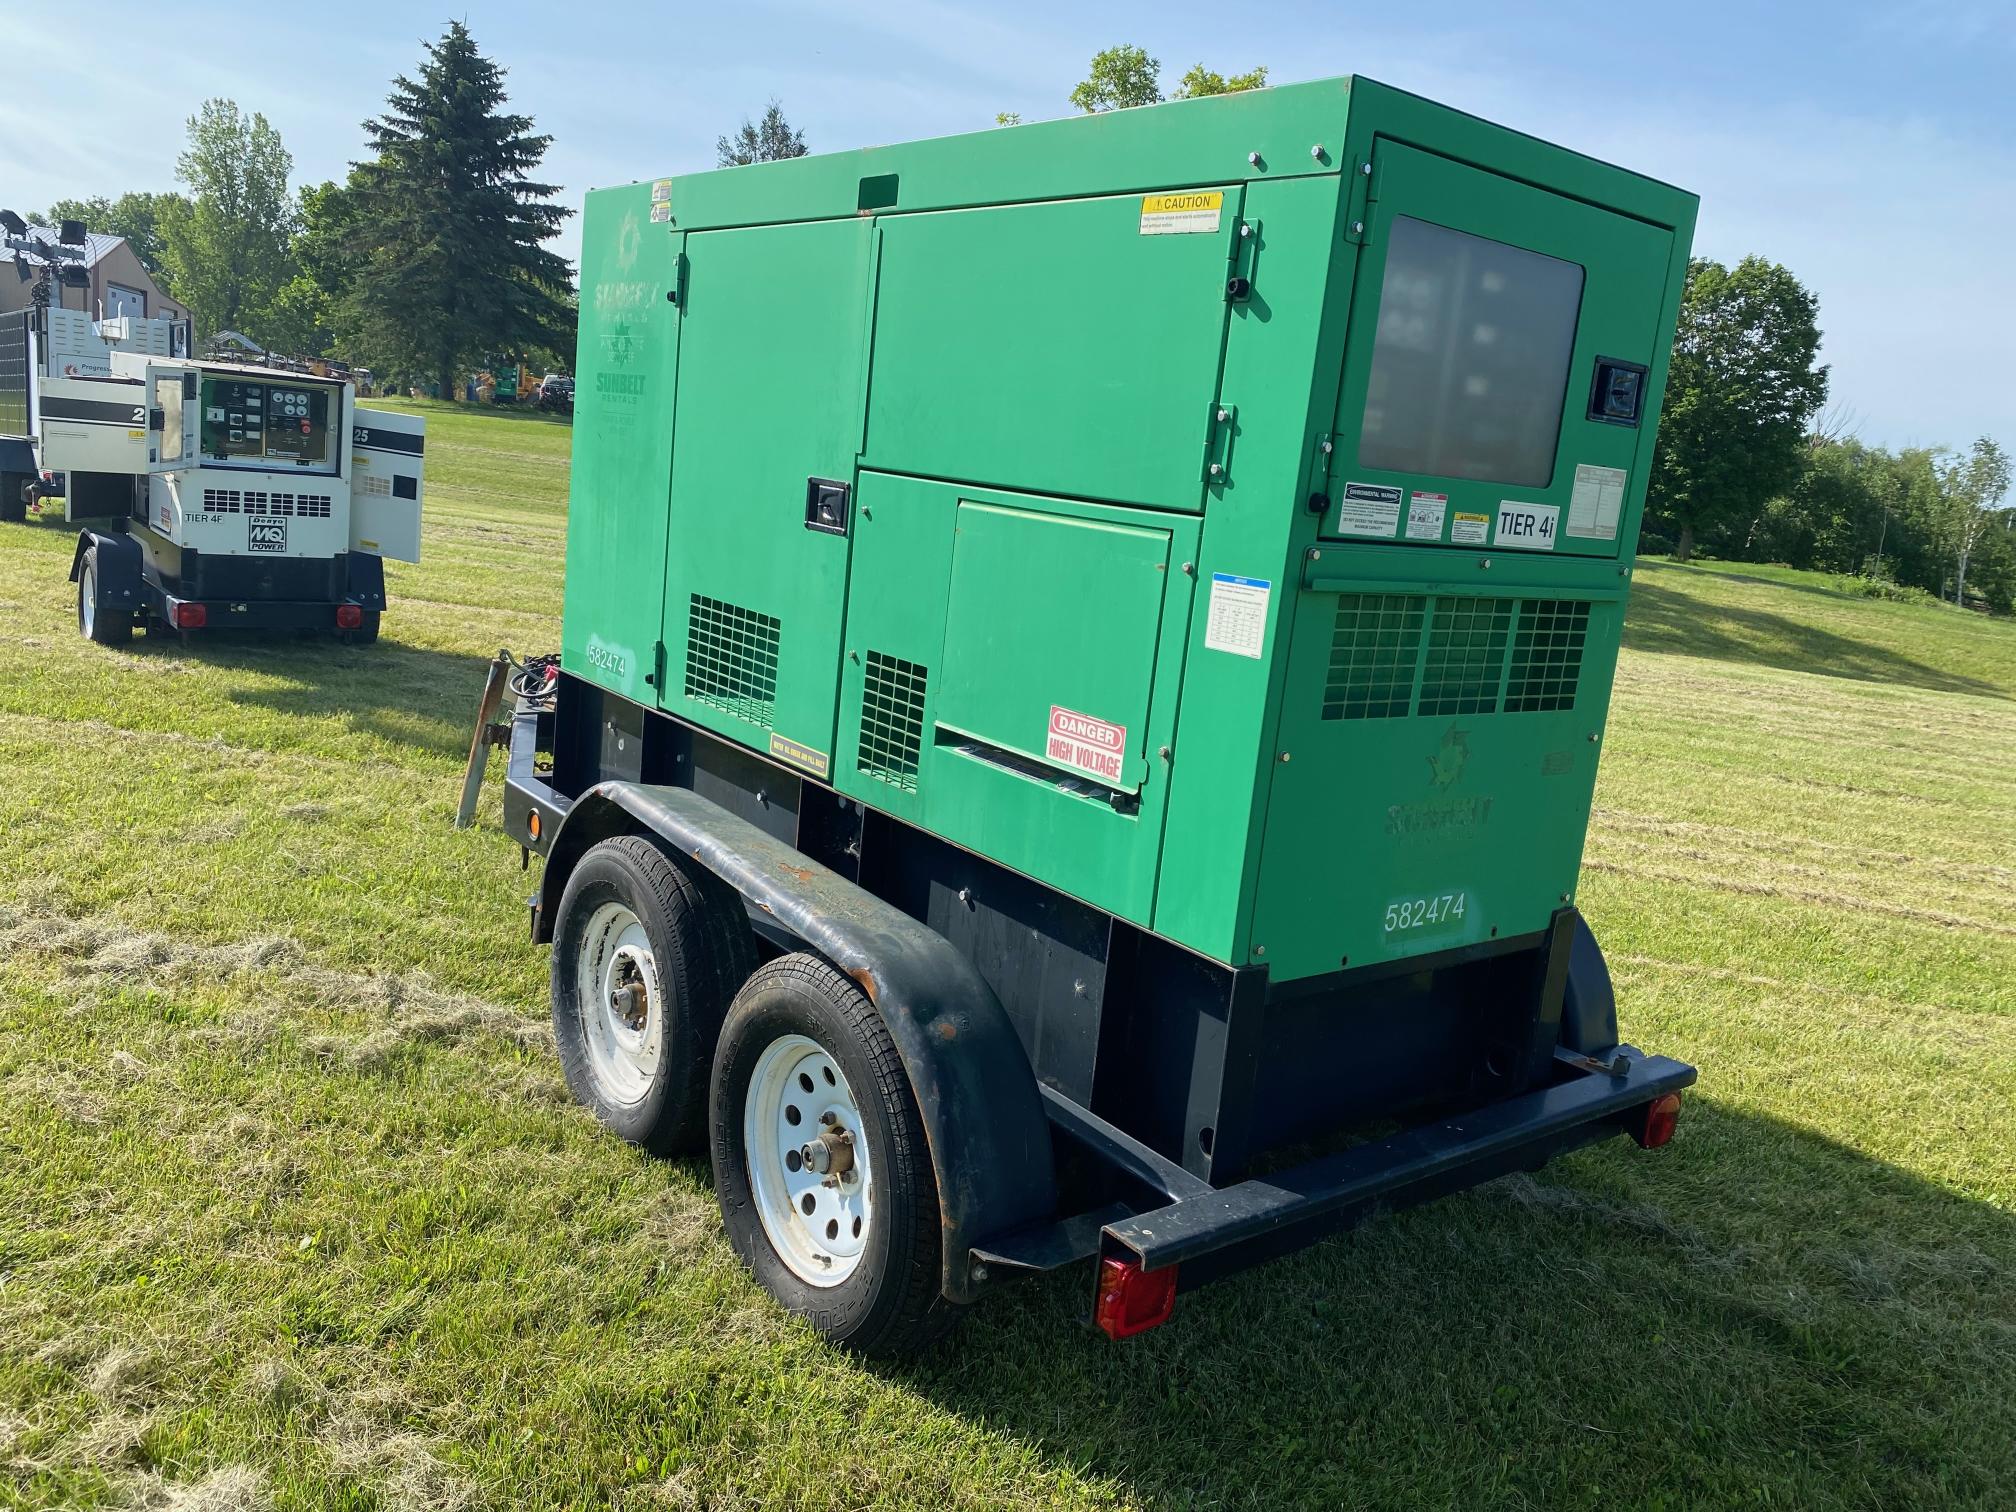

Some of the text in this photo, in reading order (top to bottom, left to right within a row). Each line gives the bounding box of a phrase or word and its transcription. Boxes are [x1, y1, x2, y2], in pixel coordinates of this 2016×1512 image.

[1164, 196, 1211, 209] CAUTION
[596, 372, 646, 395] SUNBELT
[602, 394, 638, 404] RENTALS
[354, 429, 369, 443] 25
[185, 513, 223, 523] TIER 4F
[253, 517, 284, 525] Denyo
[1501, 511, 1535, 537] TIER
[1539, 515, 1554, 538] 4i
[251, 527, 284, 542] MQ
[251, 543, 284, 551] POWER
[589, 645, 625, 677] 582474
[1058, 715, 1115, 745] DANGER
[1049, 737, 1121, 778] HIGH VOLTAGE
[1384, 892, 1465, 932] 582474
